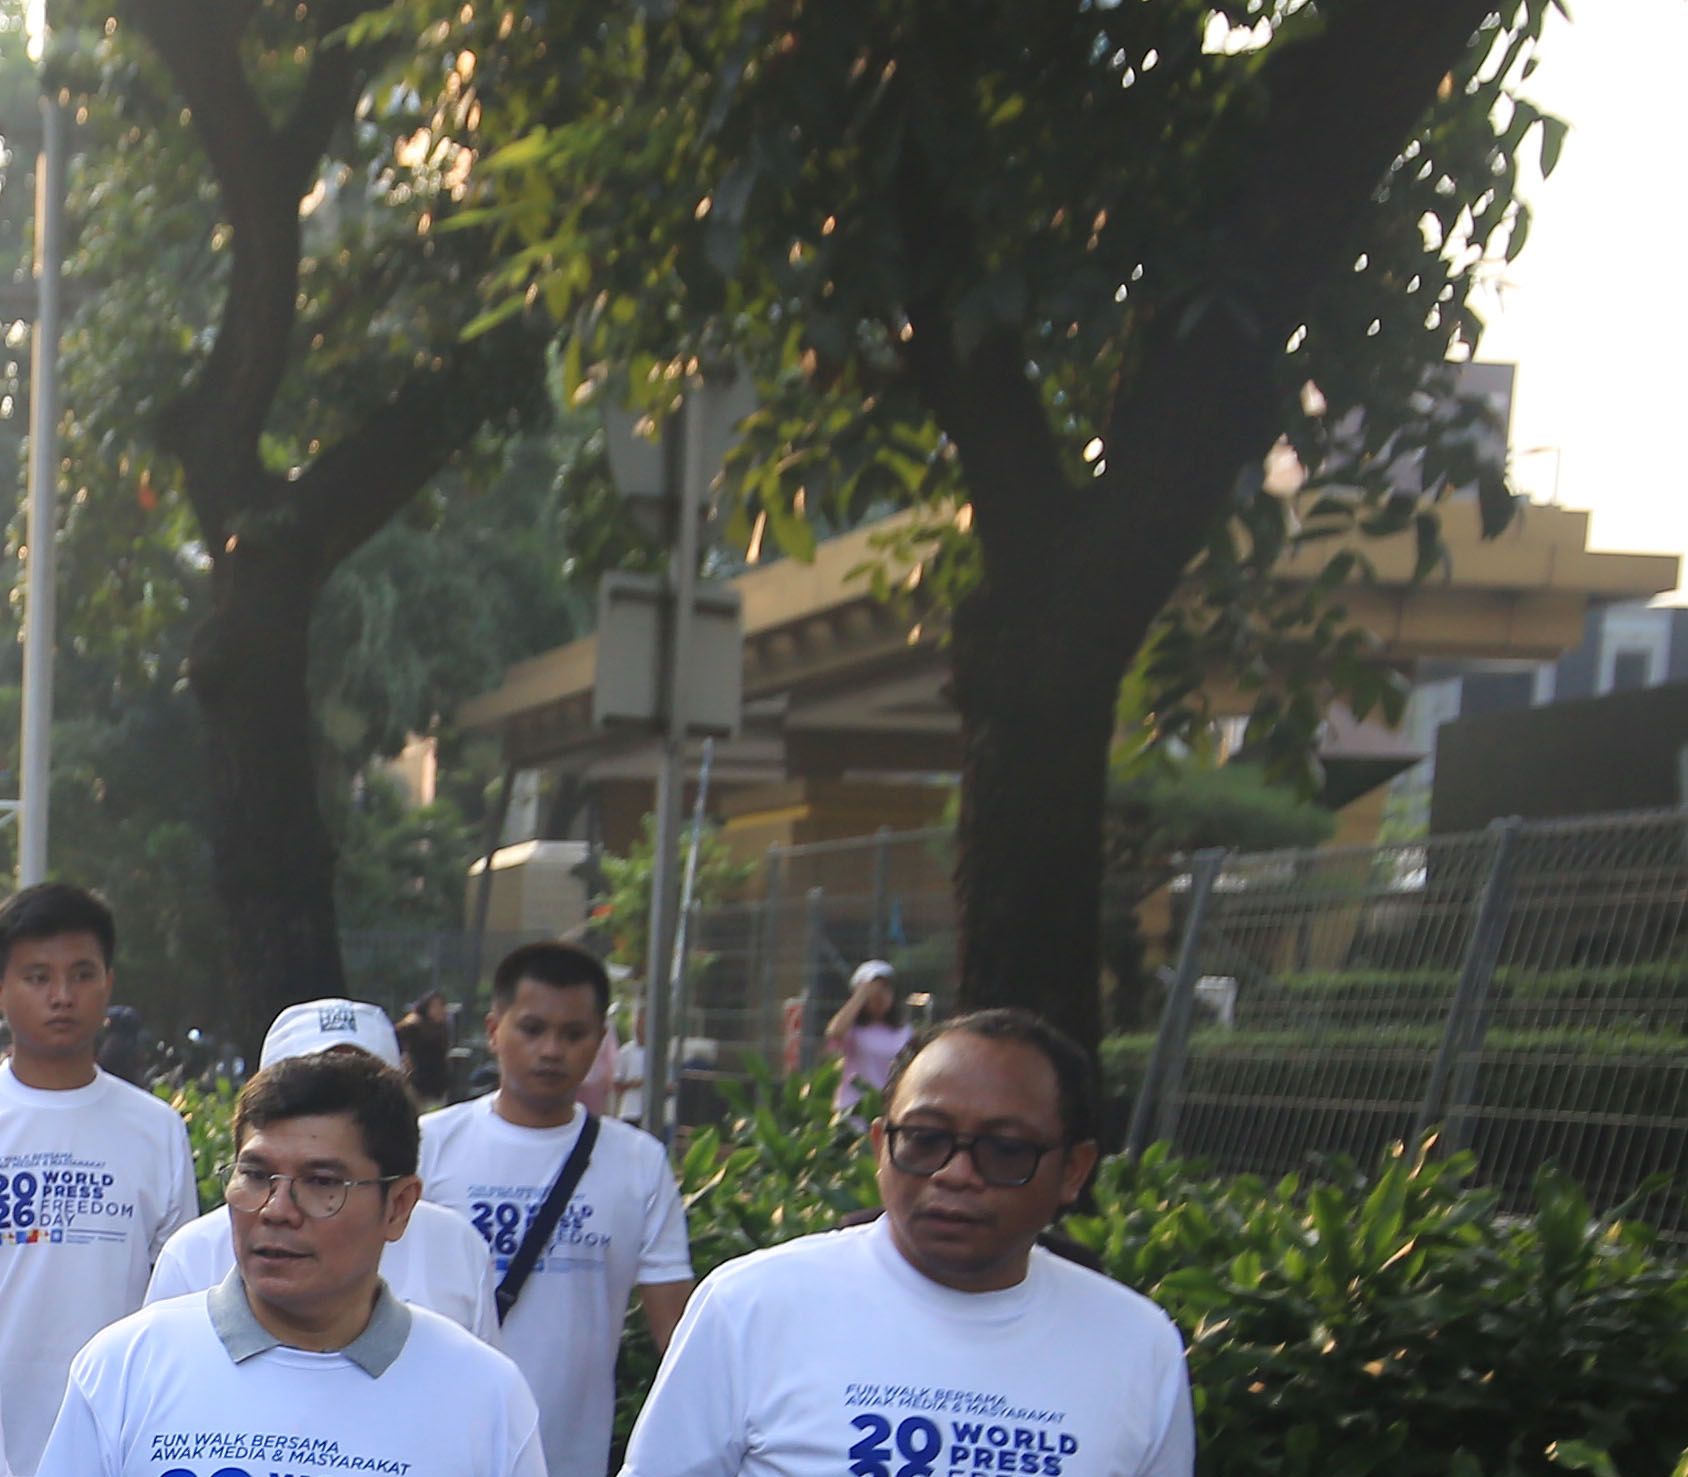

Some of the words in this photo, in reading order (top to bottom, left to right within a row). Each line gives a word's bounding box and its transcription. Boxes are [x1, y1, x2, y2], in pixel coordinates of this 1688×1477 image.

[42, 1170, 114, 1186] WORLD
[42, 1185, 104, 1200] PRESS
[39, 1199, 134, 1218] FREEDOM
[472, 1202, 520, 1229] 20
[39, 1213, 75, 1227] DAY
[845, 1383, 879, 1396] FUN
[152, 1434, 190, 1449] FUN
[195, 1433, 247, 1447] WALK
[251, 1434, 339, 1454] BERSAMA
[848, 1413, 942, 1462] 20
[950, 1420, 1078, 1456] WORLD
[151, 1448, 203, 1462] AWAK
[209, 1446, 266, 1461] MEDIA
[272, 1450, 283, 1462] &
[288, 1450, 412, 1477] MASYARAKAT
[949, 1446, 1063, 1477] PRESS
